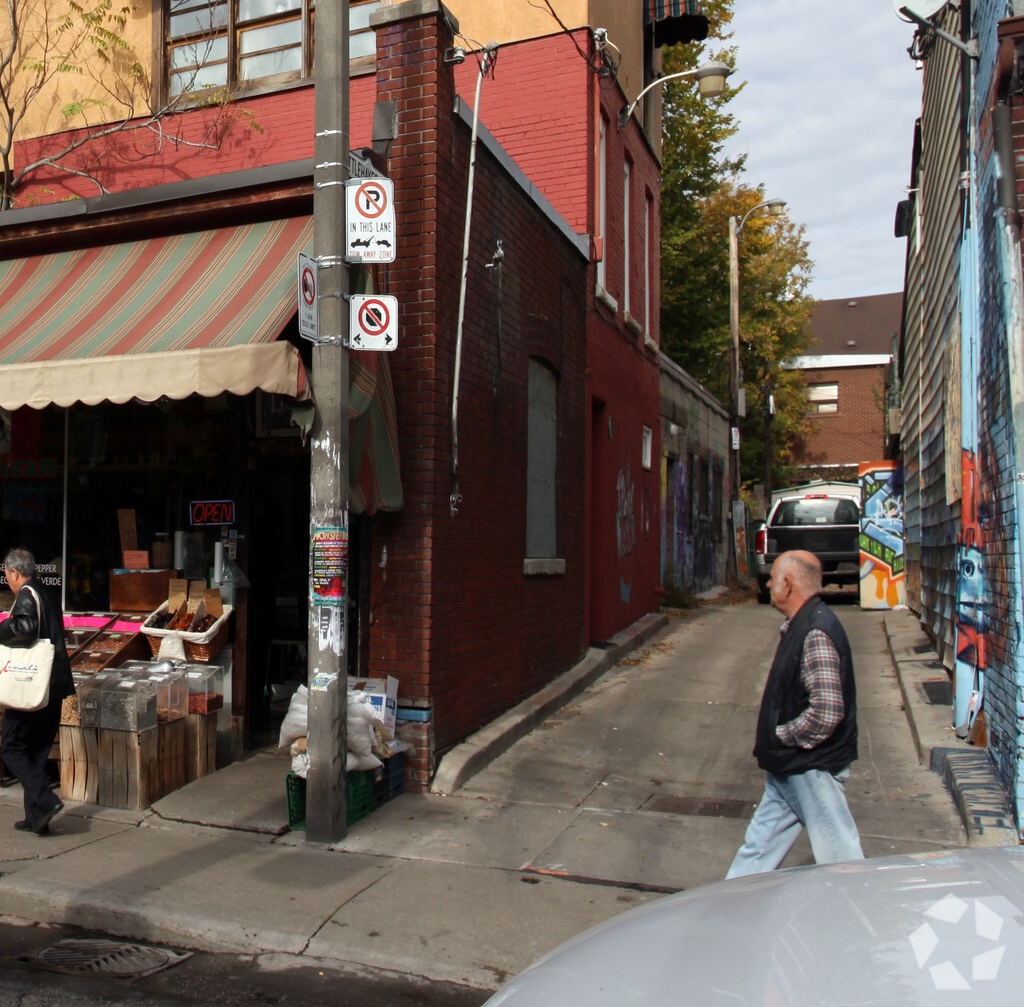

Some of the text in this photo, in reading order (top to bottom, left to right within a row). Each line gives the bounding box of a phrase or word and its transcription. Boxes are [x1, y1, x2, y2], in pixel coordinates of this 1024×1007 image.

[349, 221, 392, 233] IN THIS LANE
[363, 250, 376, 259] AWAY
[379, 250, 392, 259] ZONE
[193, 503, 232, 522] OPEN
[41, 577, 62, 586] VERDE
